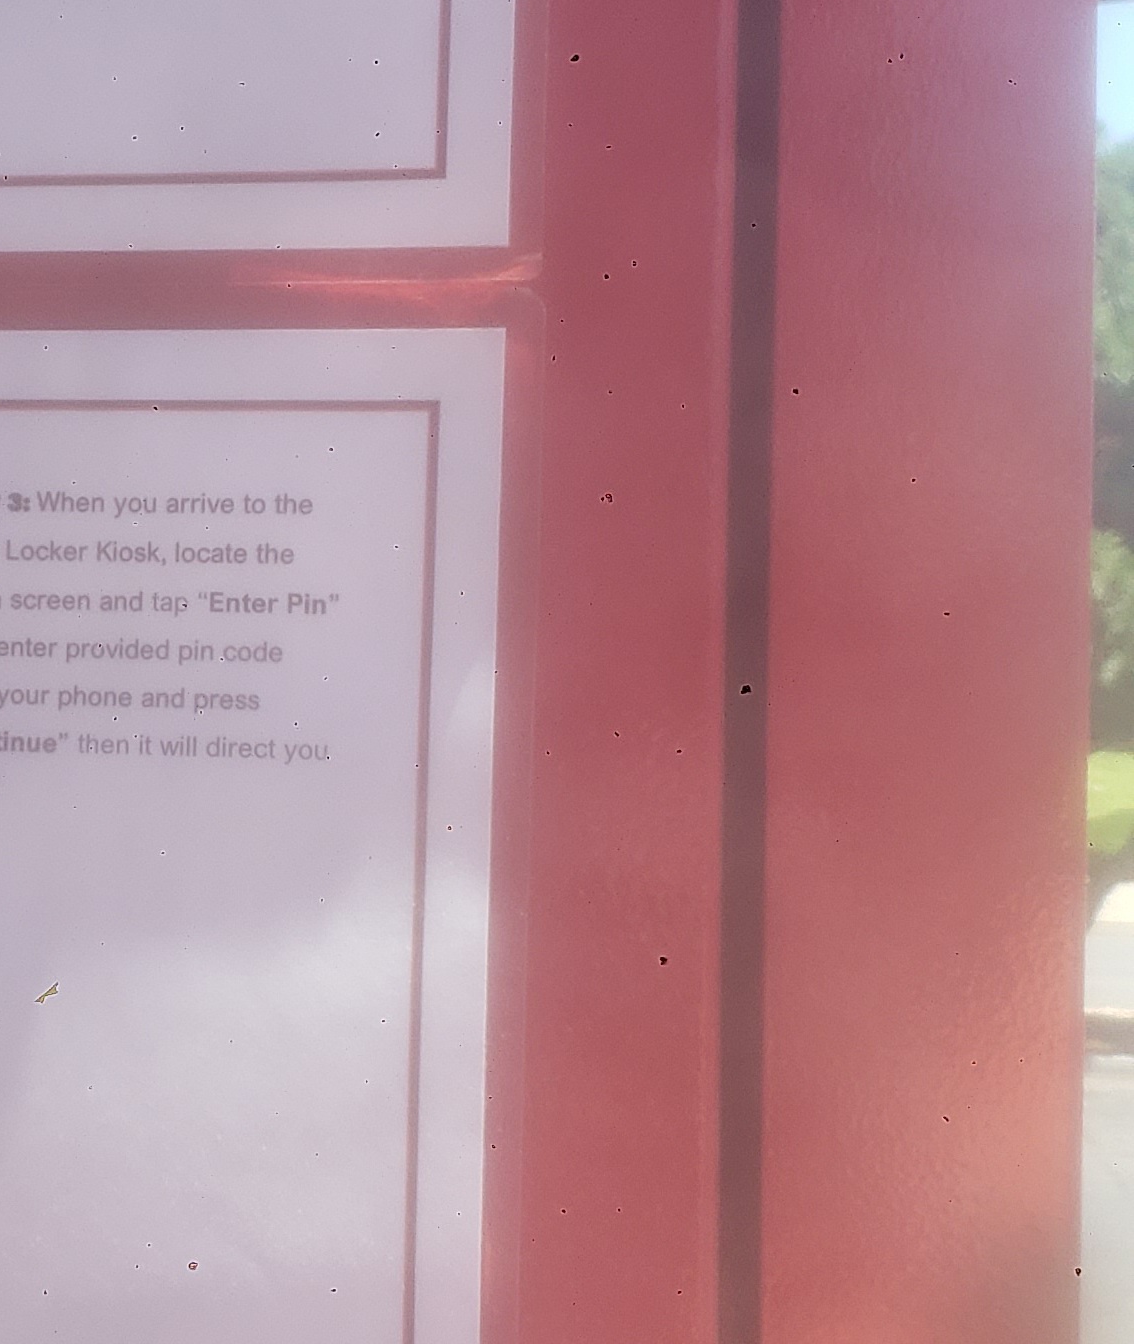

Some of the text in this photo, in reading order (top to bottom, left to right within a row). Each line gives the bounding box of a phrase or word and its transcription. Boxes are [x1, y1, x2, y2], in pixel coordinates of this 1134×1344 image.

[7, 492, 31, 513] 3:
[36, 490, 105, 514] When
[113, 496, 158, 519] you
[165, 496, 235, 515] arrive
[242, 494, 267, 515] to
[273, 494, 314, 516] the
[5, 540, 88, 563] Locker
[95, 541, 167, 566] Kiosk,
[174, 542, 248, 565] locate
[255, 543, 295, 566] the
[9, 592, 91, 612] screen
[98, 591, 144, 613] and
[151, 592, 188, 617] tap
[65, 638, 171, 664] provided
[177, 641, 215, 665] pin
[222, 641, 284, 664] code
[57, 685, 133, 711] phone
[140, 688, 186, 710] and
[192, 692, 261, 714] press
[77, 733, 130, 755] then
[138, 735, 153, 756] it
[159, 736, 198, 756] will
[204, 736, 276, 760] direct
[283, 742, 329, 766] you
